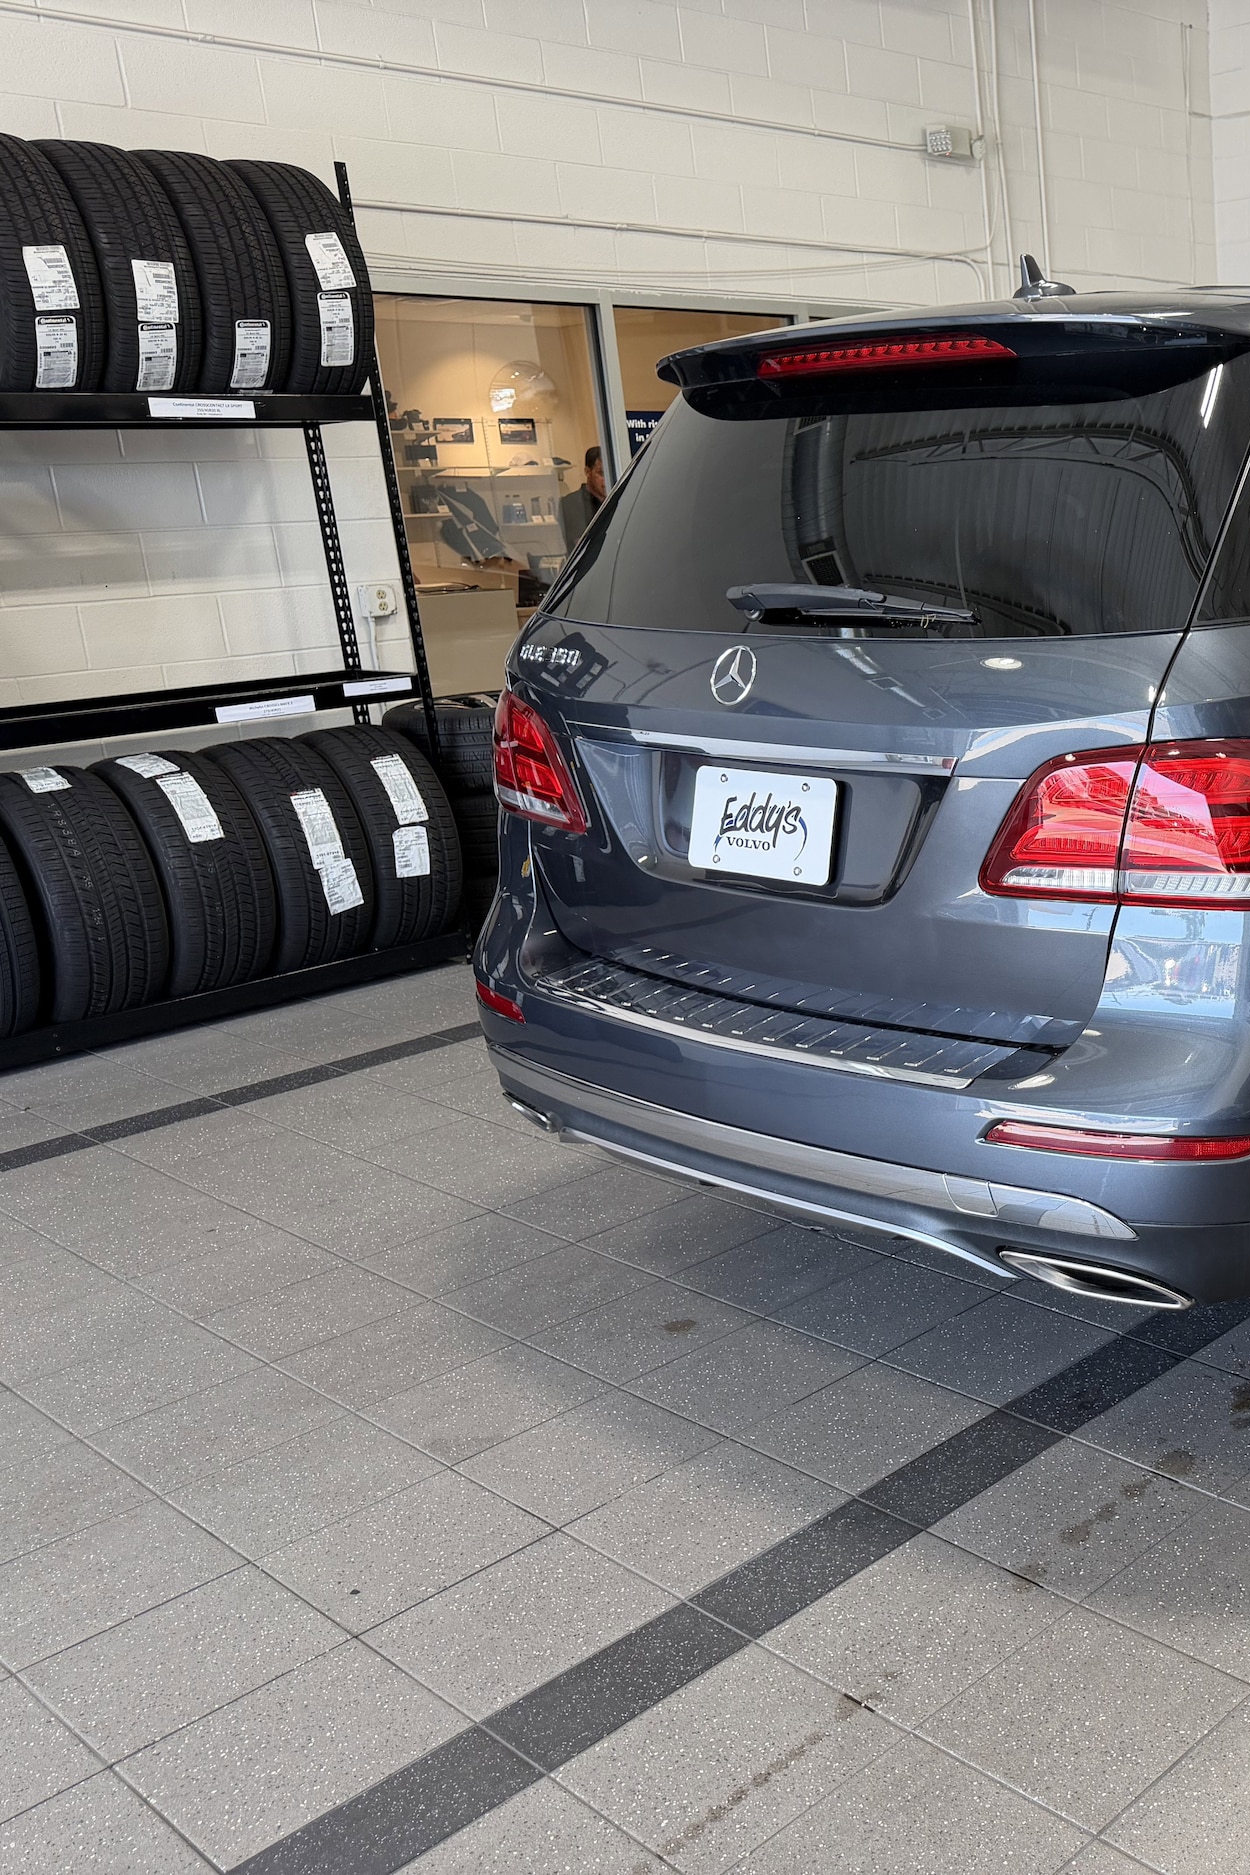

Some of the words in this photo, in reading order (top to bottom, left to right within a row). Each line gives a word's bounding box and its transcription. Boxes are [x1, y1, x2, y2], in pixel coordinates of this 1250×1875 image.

[626, 419, 647, 428] With
[635, 433, 645, 442] in
[719, 792, 802, 848] Eddy's
[726, 836, 771, 851] VOLVO
